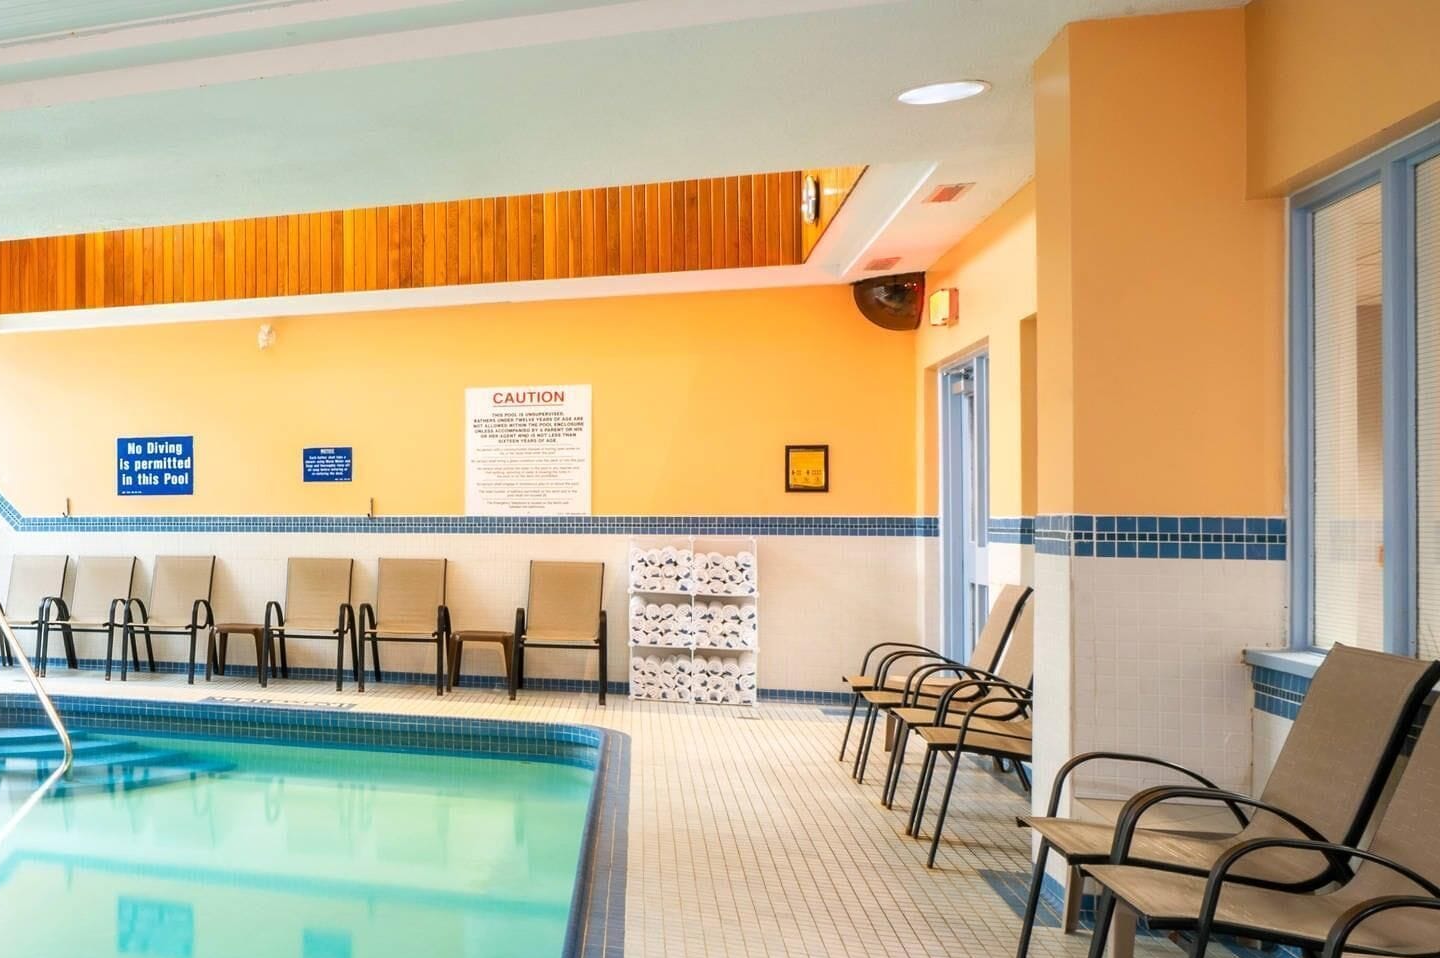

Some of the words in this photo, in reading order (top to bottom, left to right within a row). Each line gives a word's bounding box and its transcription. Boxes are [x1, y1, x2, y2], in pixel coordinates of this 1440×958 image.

[492, 391, 564, 404] CAUTION
[128, 442, 142, 454] No
[147, 442, 182, 455] Diving
[120, 458, 130, 470] is
[134, 457, 191, 472] permitted
[122, 474, 132, 485] in
[138, 473, 159, 485] this
[164, 472, 188, 485] Pool
